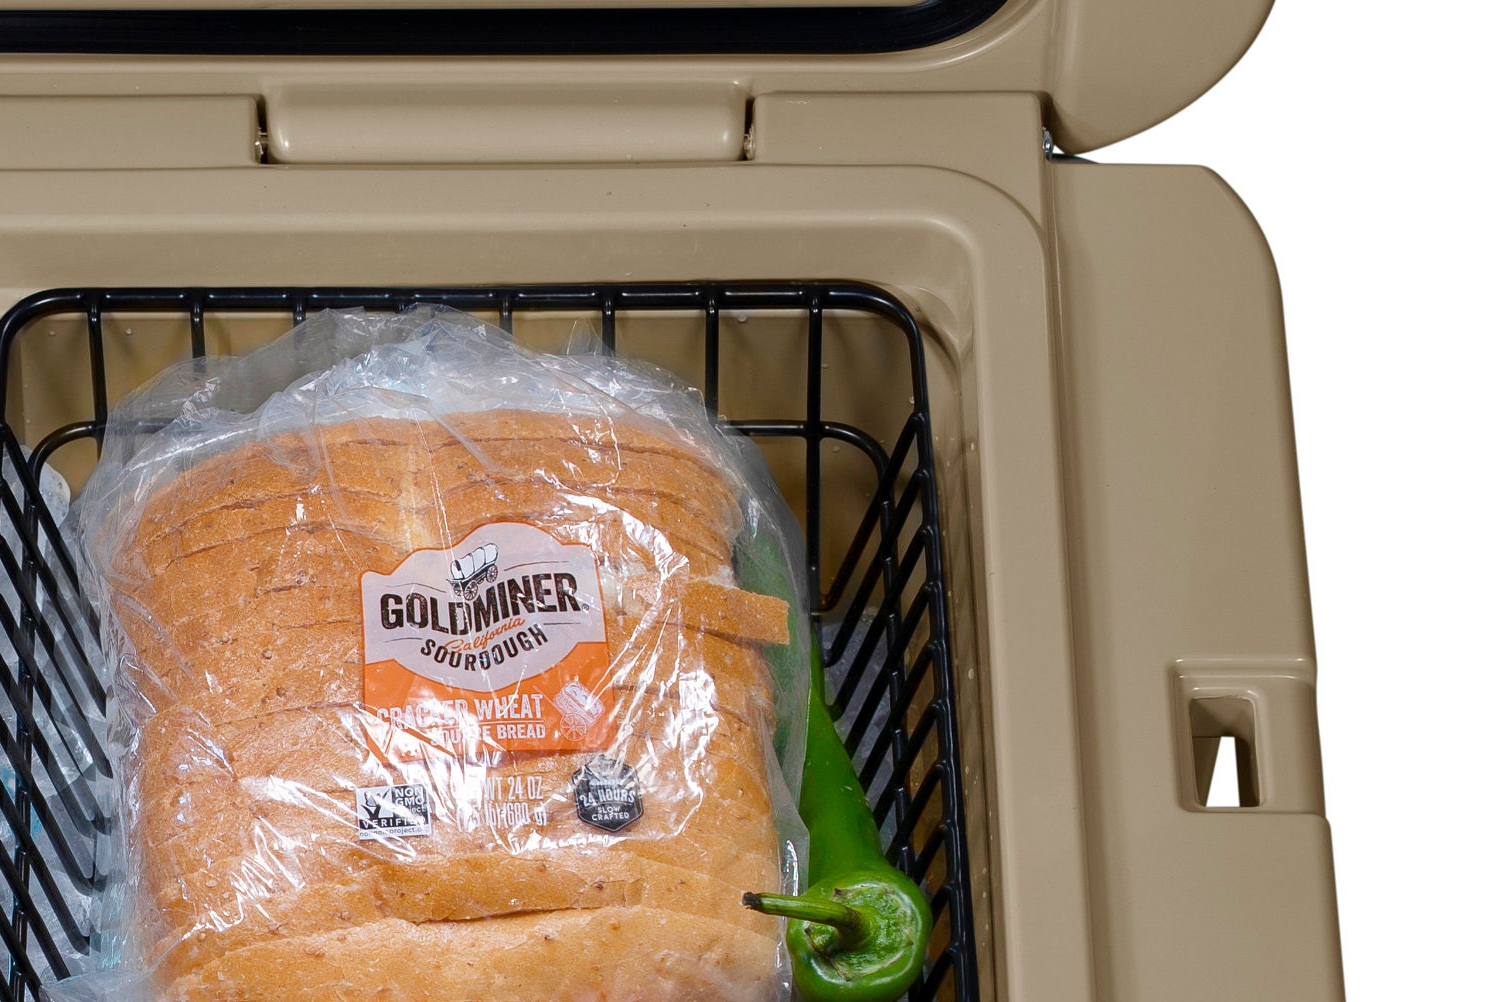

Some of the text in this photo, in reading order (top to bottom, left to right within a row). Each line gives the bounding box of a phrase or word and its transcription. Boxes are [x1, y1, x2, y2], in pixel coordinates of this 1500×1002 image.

[380, 573, 581, 636] GOLDMINER
[445, 618, 526, 654] California
[421, 623, 548, 671] SOURDOUGH
[473, 694, 544, 720] WHEAT
[497, 724, 546, 739] BREAD
[395, 787, 423, 798] NON
[507, 777, 523, 800] 24
[527, 776, 543, 800] OZ
[580, 789, 636, 807] 24 HOURS
[395, 797, 424, 806] GMO
[592, 812, 629, 820] CRAFTED
